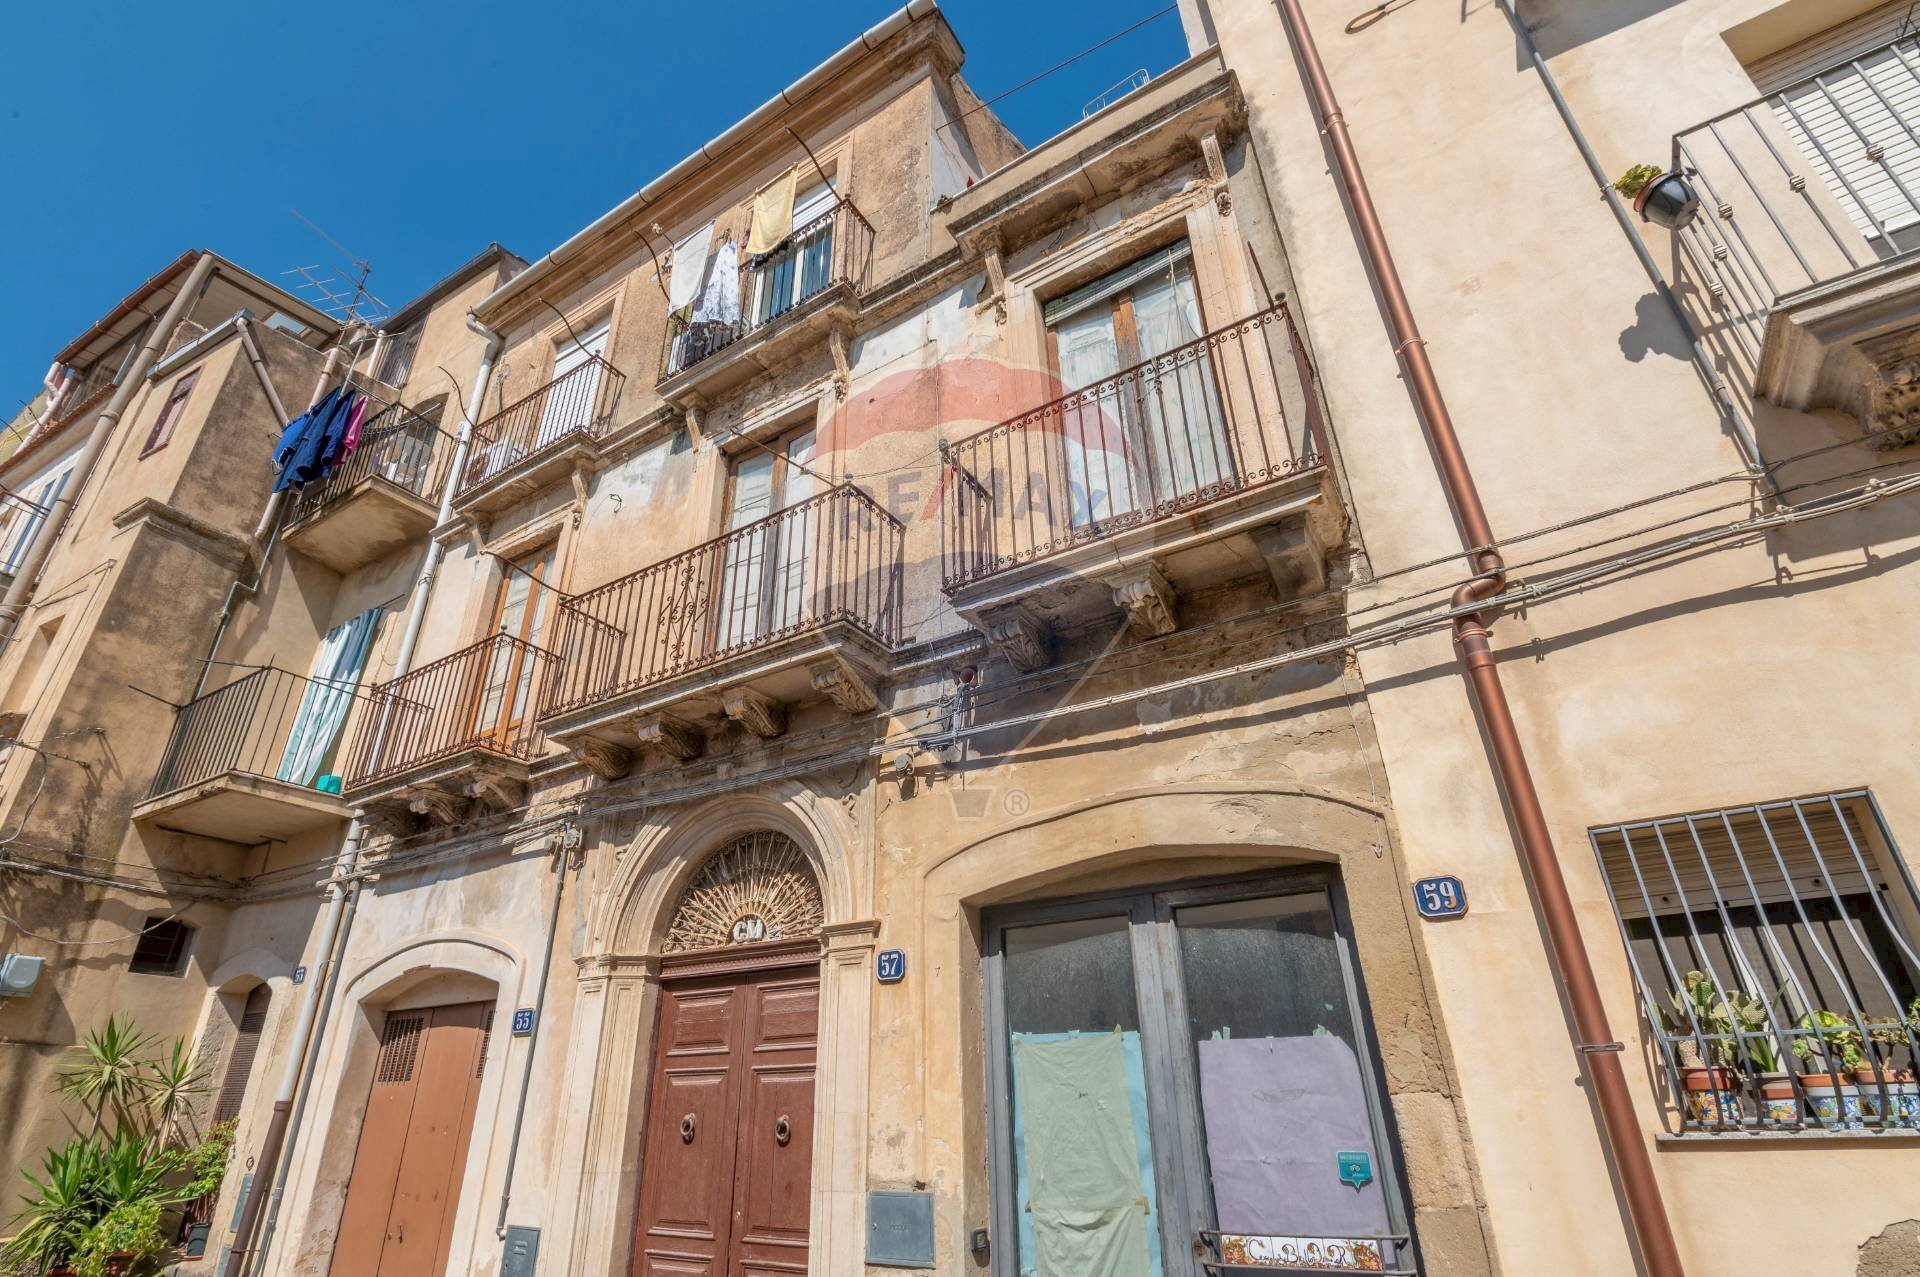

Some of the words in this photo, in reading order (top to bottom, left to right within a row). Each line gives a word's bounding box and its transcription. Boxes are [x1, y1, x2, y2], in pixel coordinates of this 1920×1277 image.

[1422, 881, 1457, 911] 59
[733, 918, 763, 943] CM
[881, 953, 899, 976] 57
[515, 1011, 531, 1030] 55
